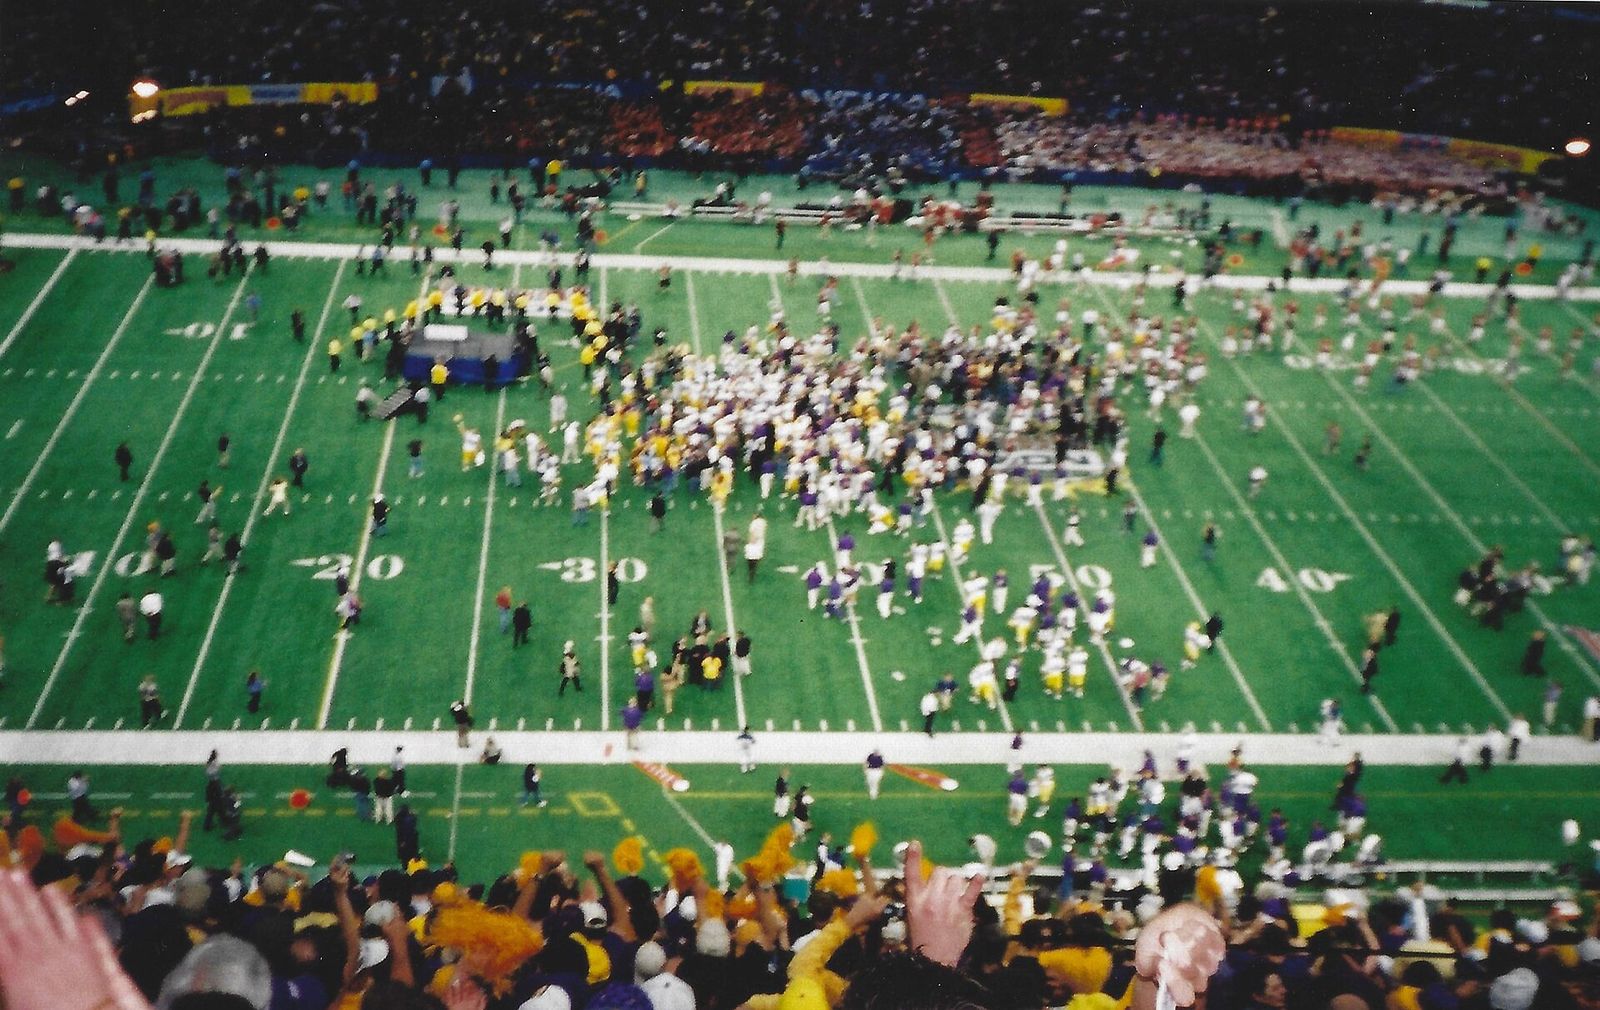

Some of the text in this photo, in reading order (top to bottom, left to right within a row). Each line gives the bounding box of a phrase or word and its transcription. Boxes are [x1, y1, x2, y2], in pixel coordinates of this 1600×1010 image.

[312, 553, 405, 580] 20
[561, 556, 648, 582] 30
[1029, 564, 1113, 588] 50
[1256, 567, 1336, 592] 40
